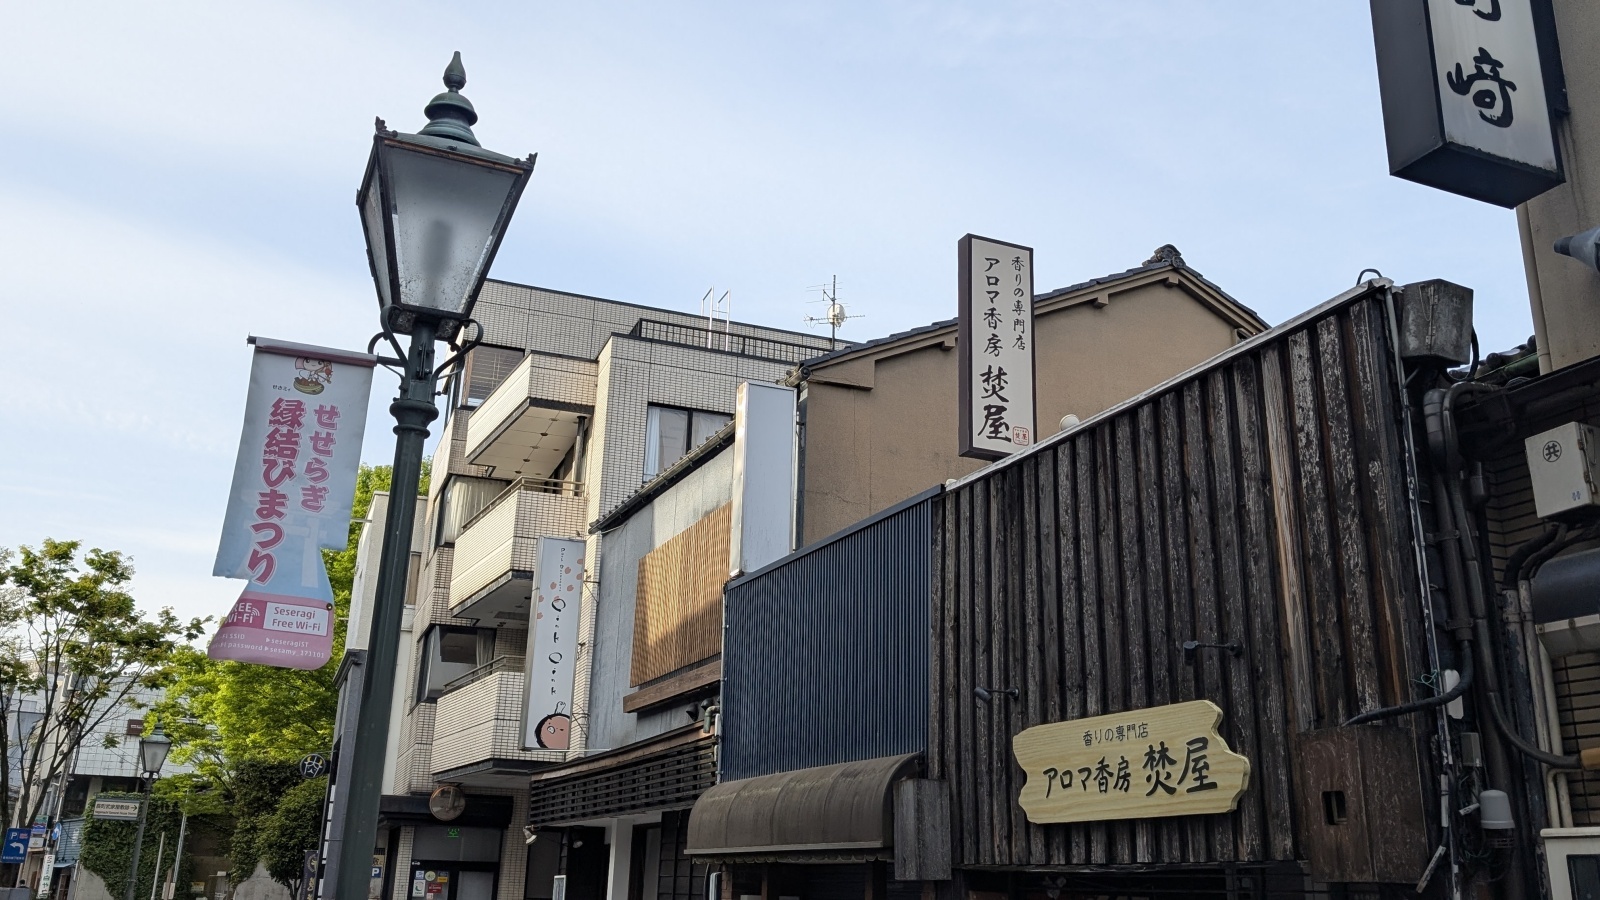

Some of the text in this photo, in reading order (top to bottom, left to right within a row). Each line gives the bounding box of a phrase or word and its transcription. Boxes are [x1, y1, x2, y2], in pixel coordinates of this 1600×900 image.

[1446, 0, 1517, 128] 崎
[1011, 255, 1026, 351] 香りの専門店
[977, 257, 1012, 443] アロマ香房 焚屋
[299, 403, 341, 513] せせらぎ
[247, 397, 306, 586] 縁結びまつり
[232, 602, 253, 613] REE
[272, 618, 321, 631] Free Wi-Fi
[274, 606, 316, 619] Seseragi
[227, 642, 263, 650] password
[1082, 722, 1149, 747] 香りの専門店
[1043, 736, 1218, 799] アロマ香房 焚屋
[371, 868, 380, 877] P
